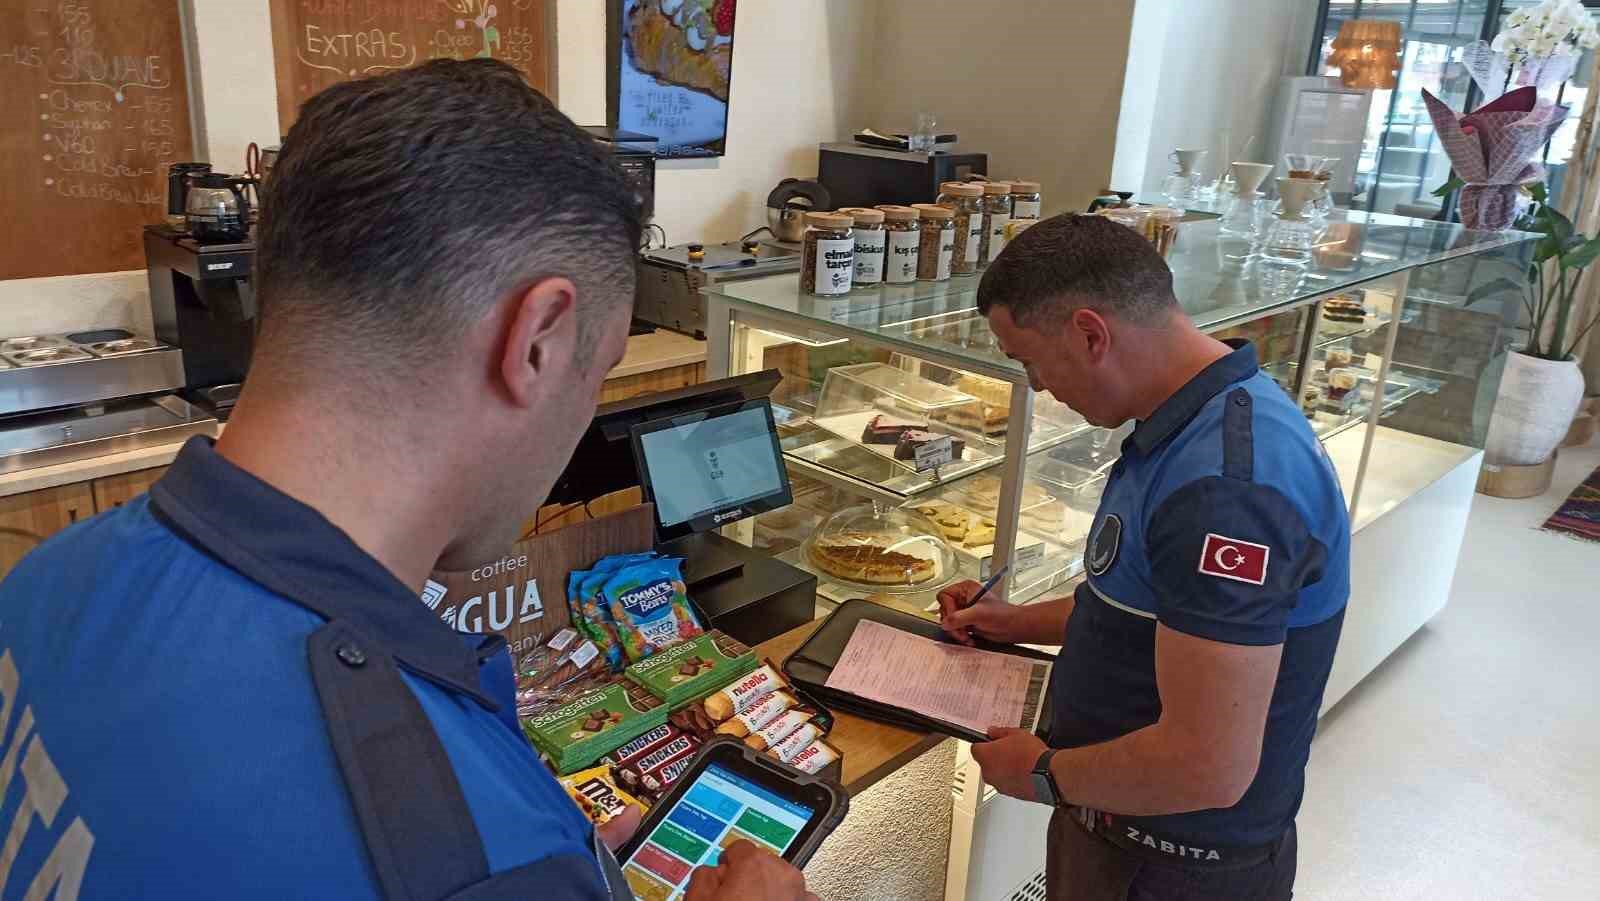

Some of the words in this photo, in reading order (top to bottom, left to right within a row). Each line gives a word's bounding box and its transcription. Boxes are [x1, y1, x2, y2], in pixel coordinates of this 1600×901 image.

[306, 24, 407, 60] EXTRAS
[471, 556, 528, 581] coffee
[732, 672, 769, 697] nutella
[619, 725, 670, 759] SNICKERS
[639, 736, 690, 771] SNICKERS
[1127, 827, 1221, 861] ZABITA
